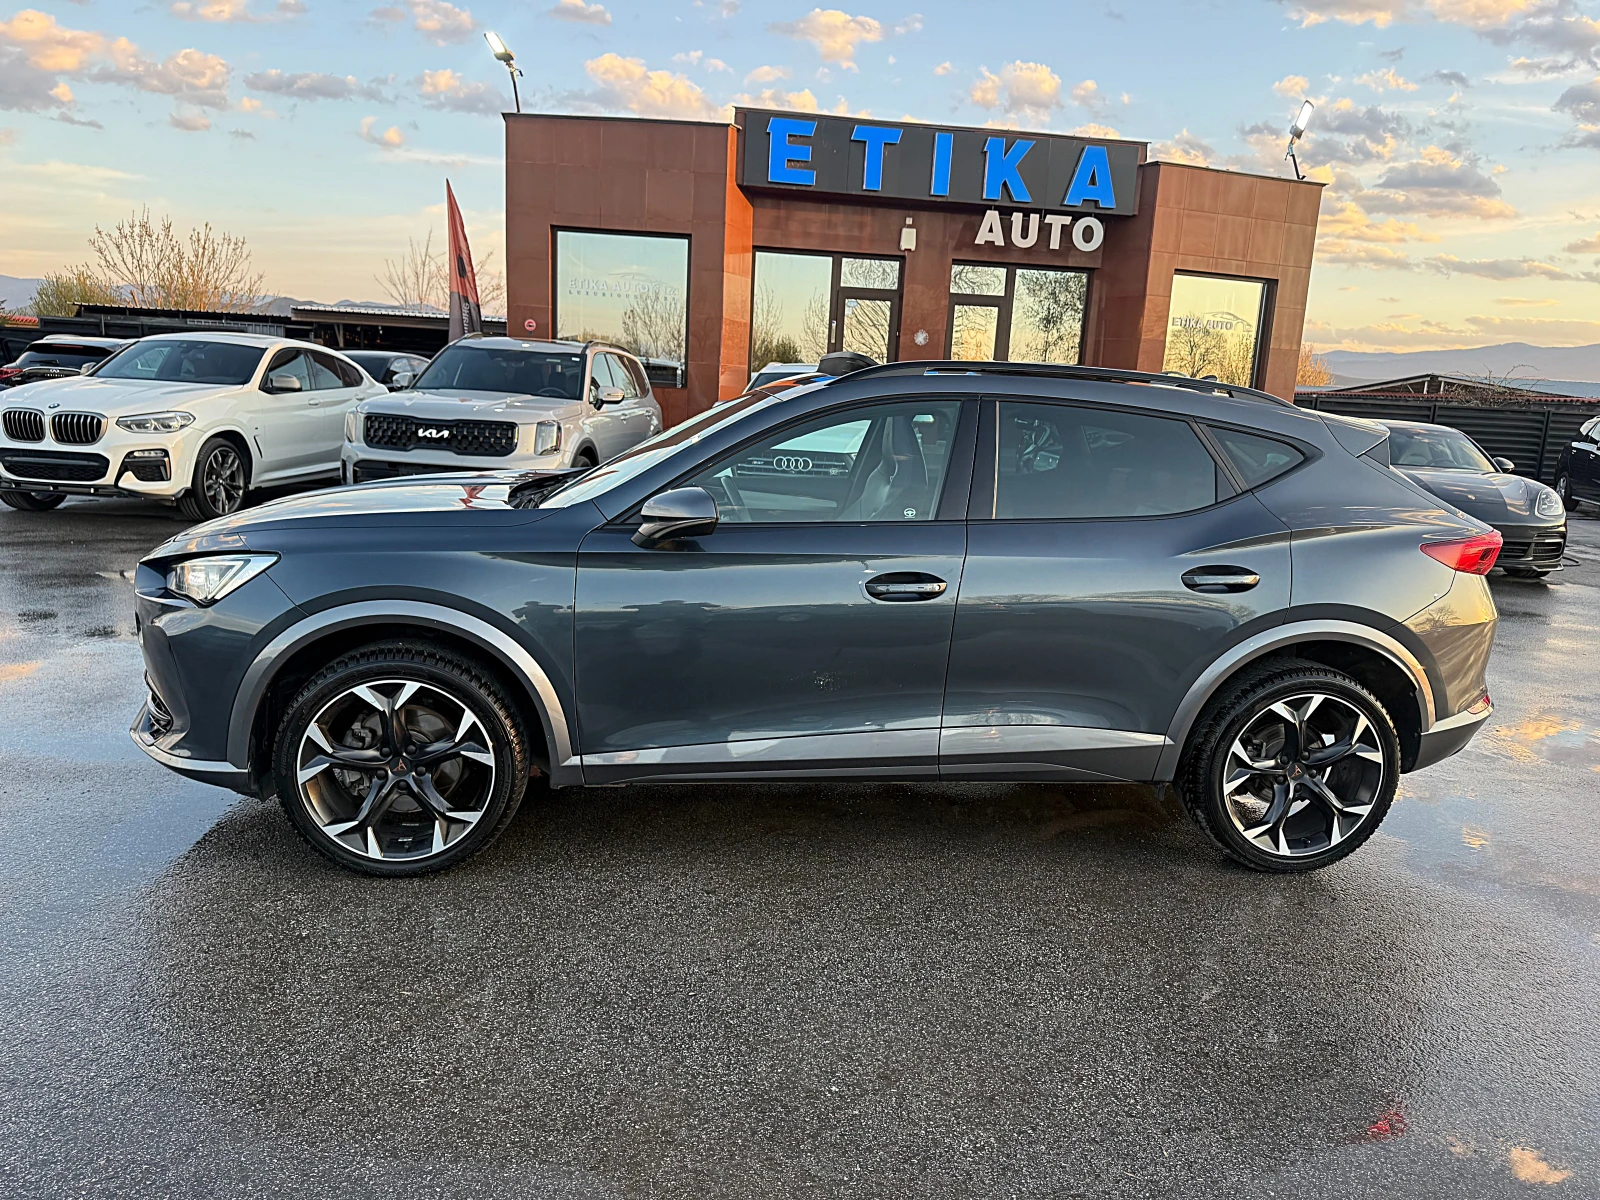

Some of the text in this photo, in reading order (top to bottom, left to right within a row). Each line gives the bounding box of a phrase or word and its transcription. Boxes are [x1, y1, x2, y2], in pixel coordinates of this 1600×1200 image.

[767, 117, 1116, 209] ETIKA
[974, 209, 1105, 252] AUTO
[570, 278, 650, 293] ETIKA AUTO
[1172, 316, 1234, 331] ETIKA AUTO
